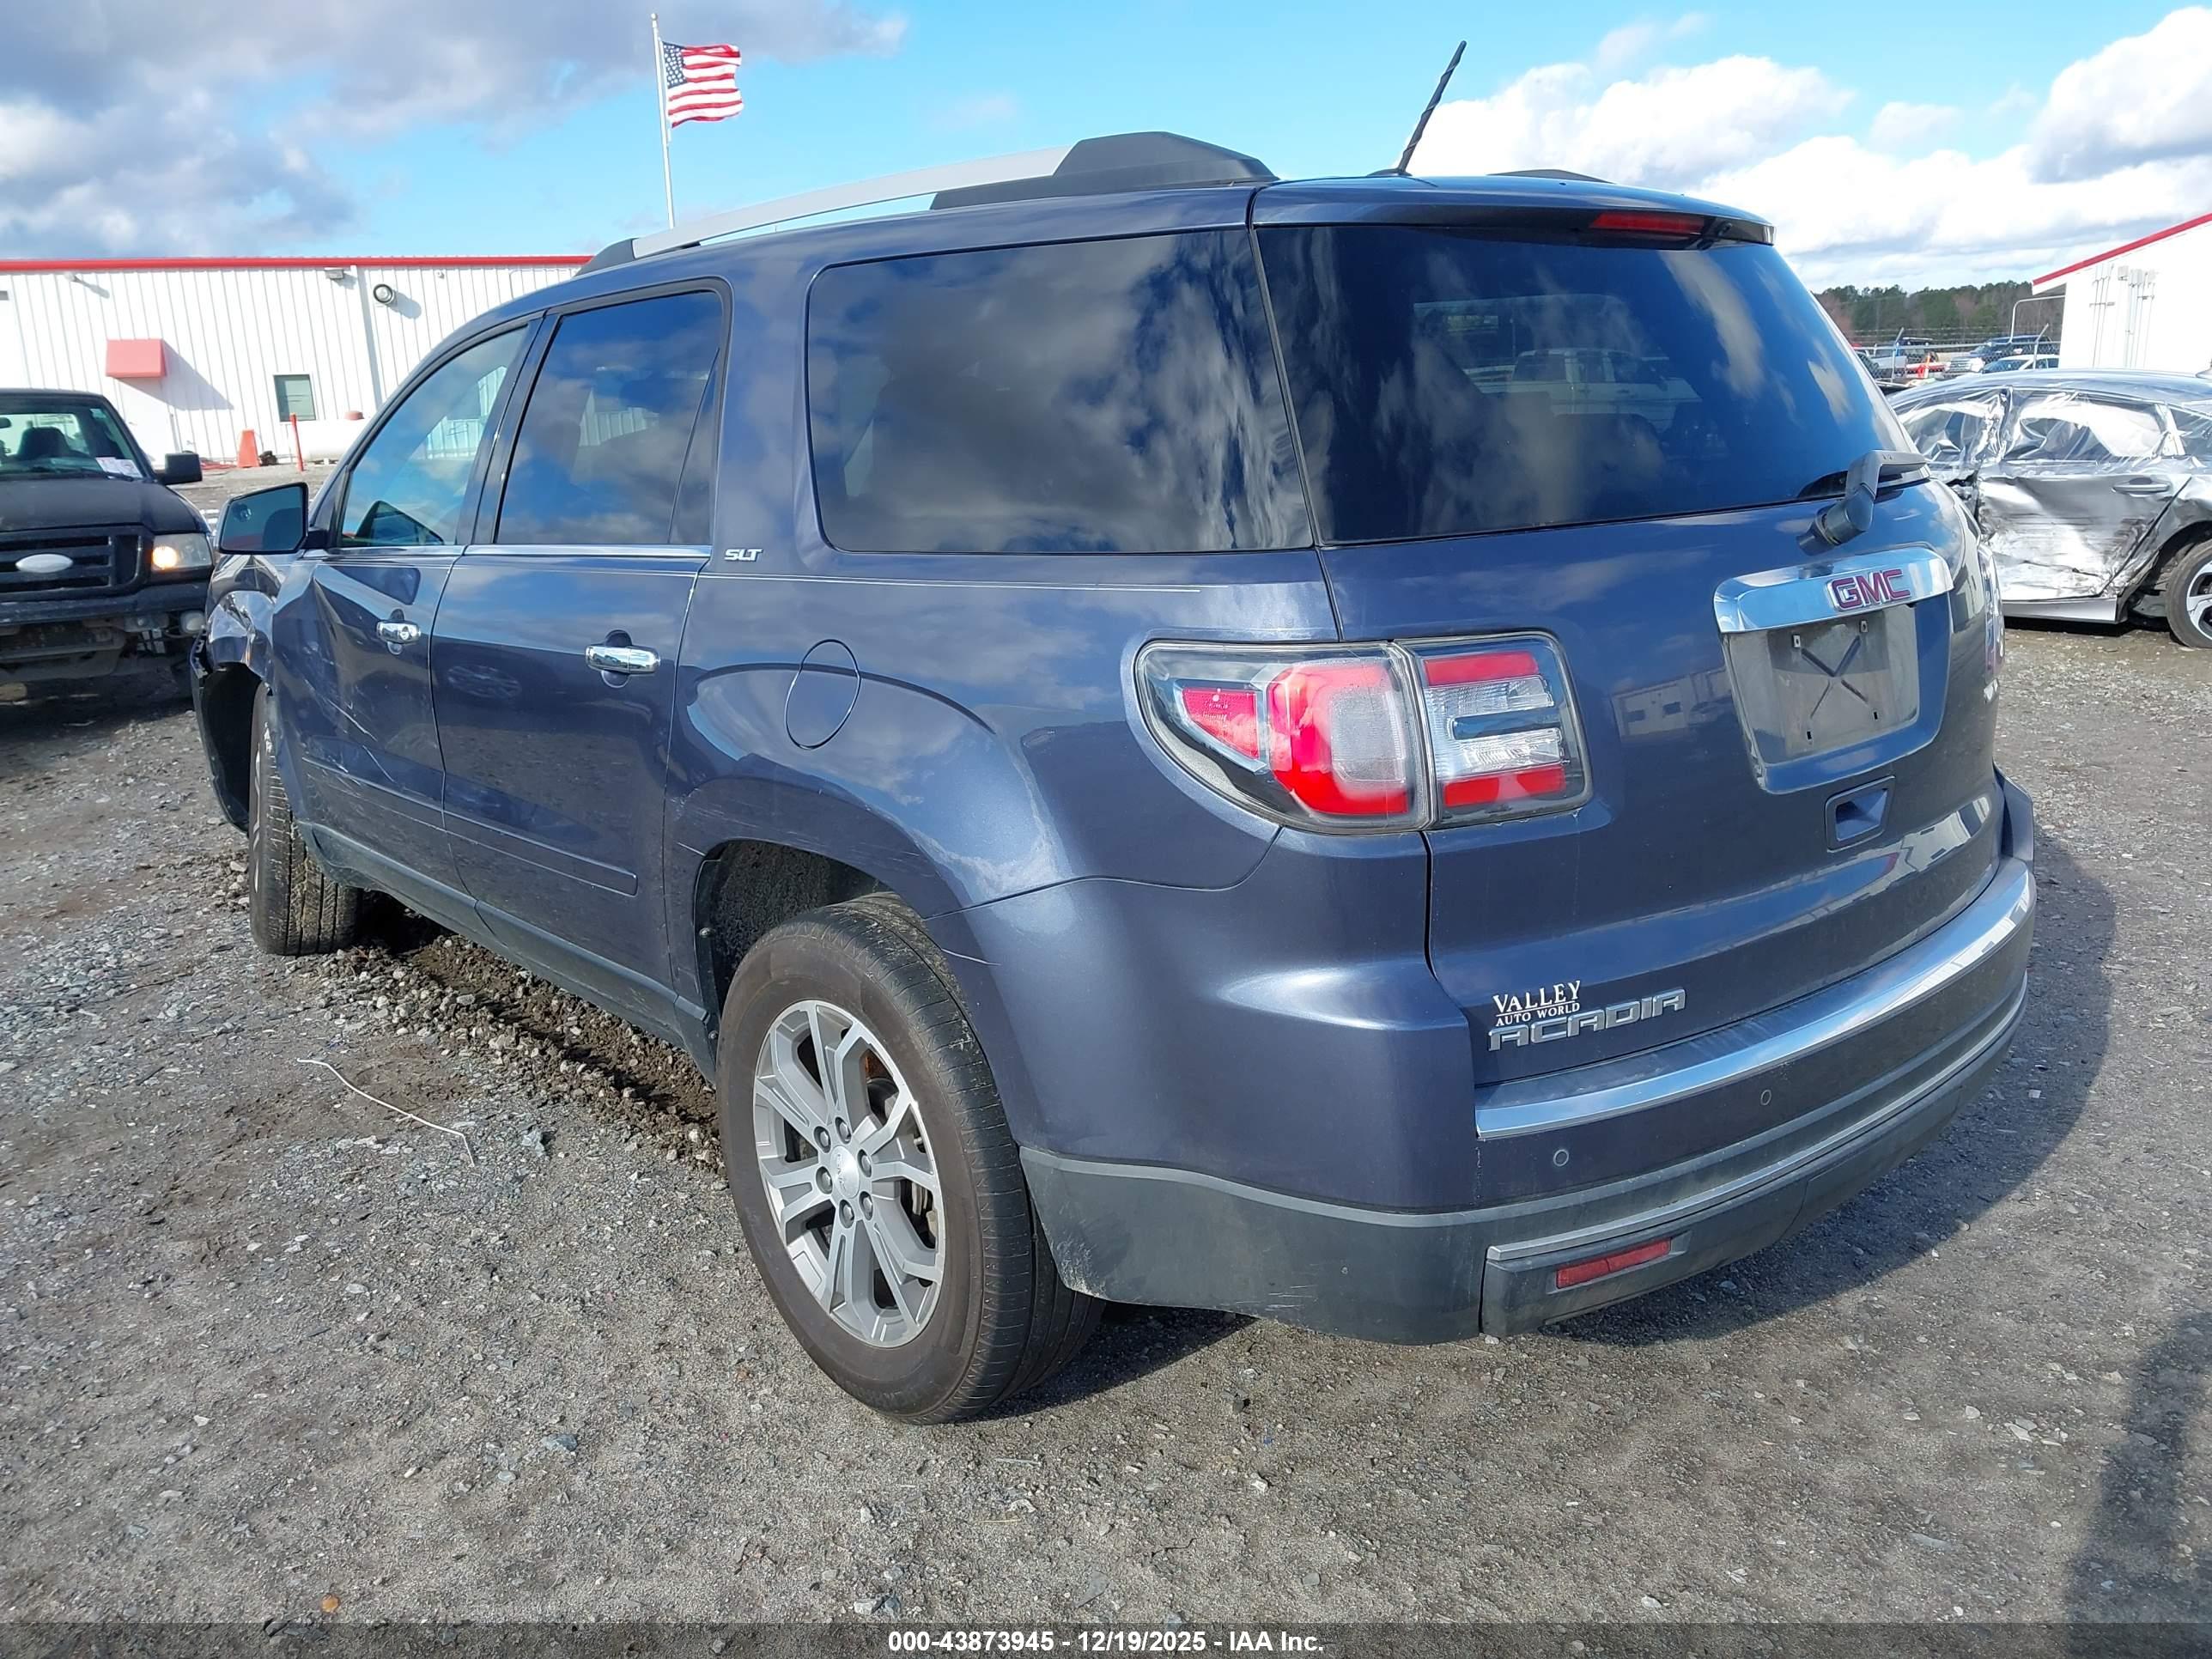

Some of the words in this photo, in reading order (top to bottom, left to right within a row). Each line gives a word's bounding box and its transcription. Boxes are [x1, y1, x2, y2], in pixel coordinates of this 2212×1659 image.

[724, 548, 763, 562] SLT
[1829, 568, 1911, 611] GMC
[1492, 980, 1581, 1013] VALLEY
[1487, 988, 1687, 1052] ACADIA
[1495, 1012, 1531, 1027] AUTO
[1536, 1002, 1581, 1019] WORLD
